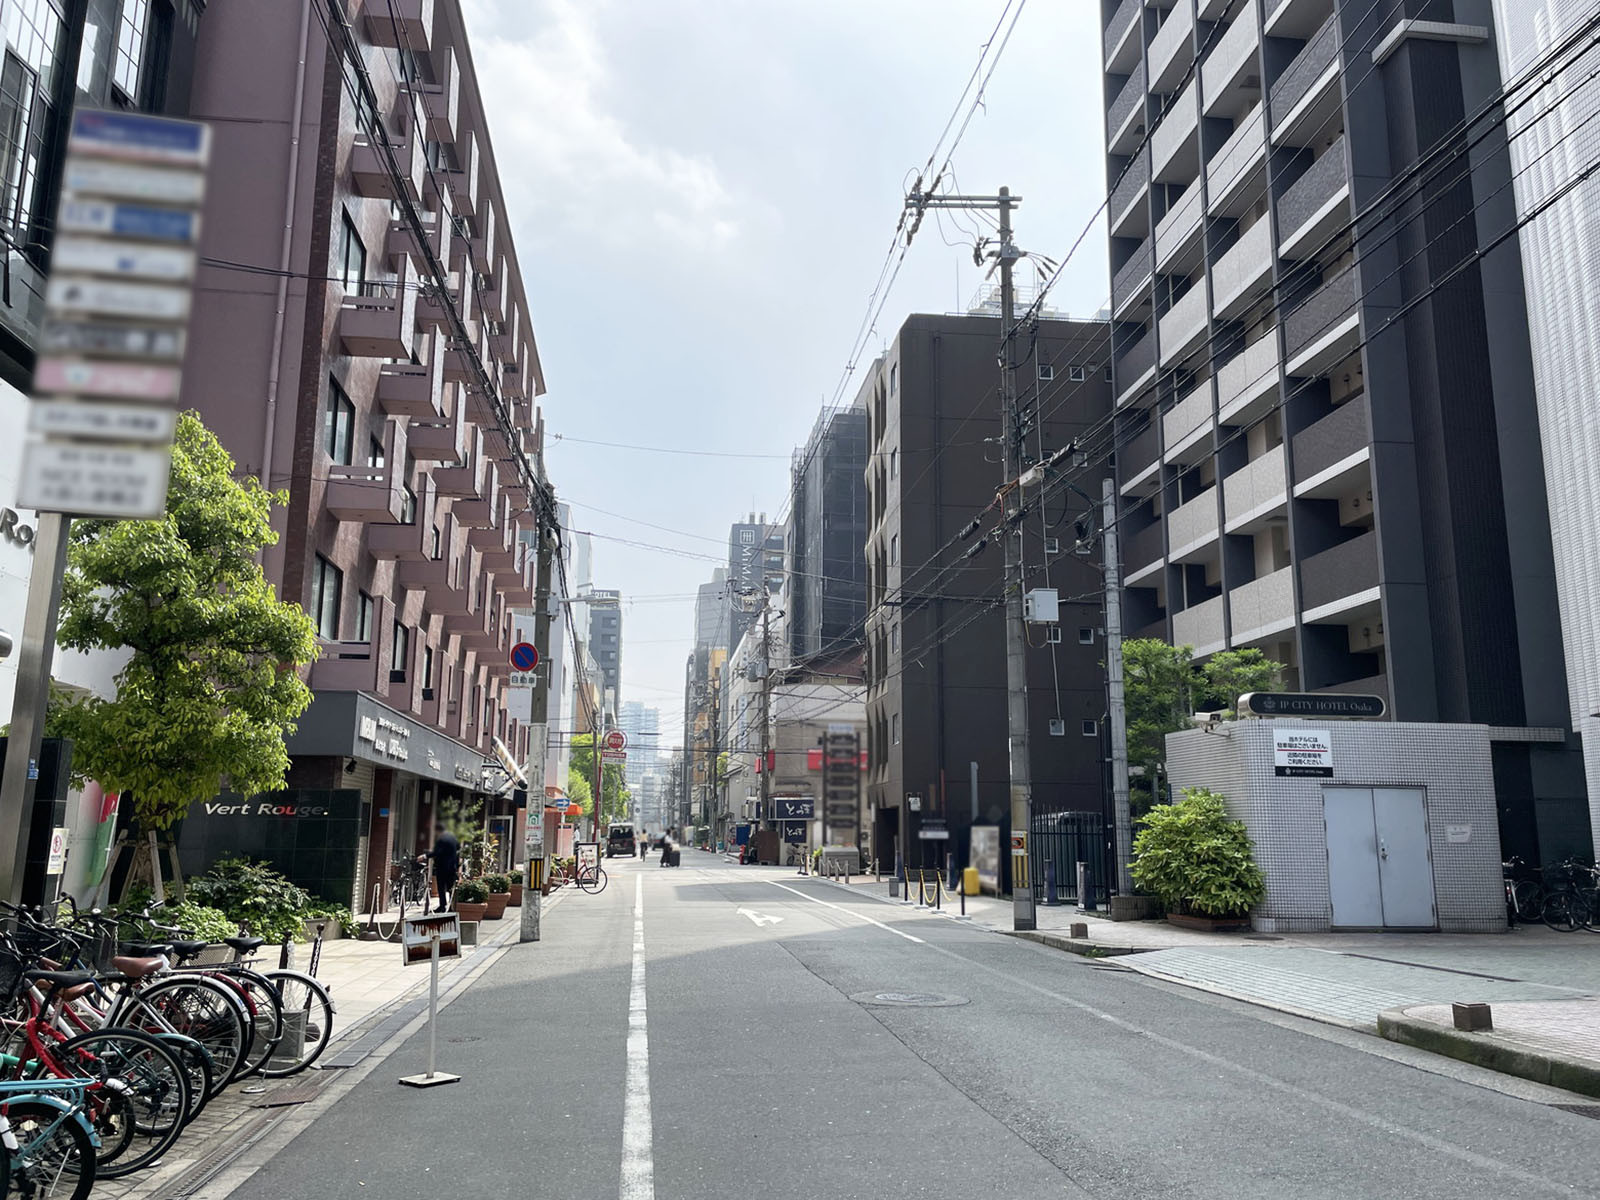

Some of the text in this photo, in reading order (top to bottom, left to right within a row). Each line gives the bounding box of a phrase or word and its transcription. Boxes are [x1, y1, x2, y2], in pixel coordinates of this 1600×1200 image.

[0, 507, 37, 549] Ro
[1292, 700, 1313, 710] CITY
[1316, 701, 1348, 710] HOTEL
[1350, 702, 1372, 711] Osaka
[204, 803, 251, 815] Vert
